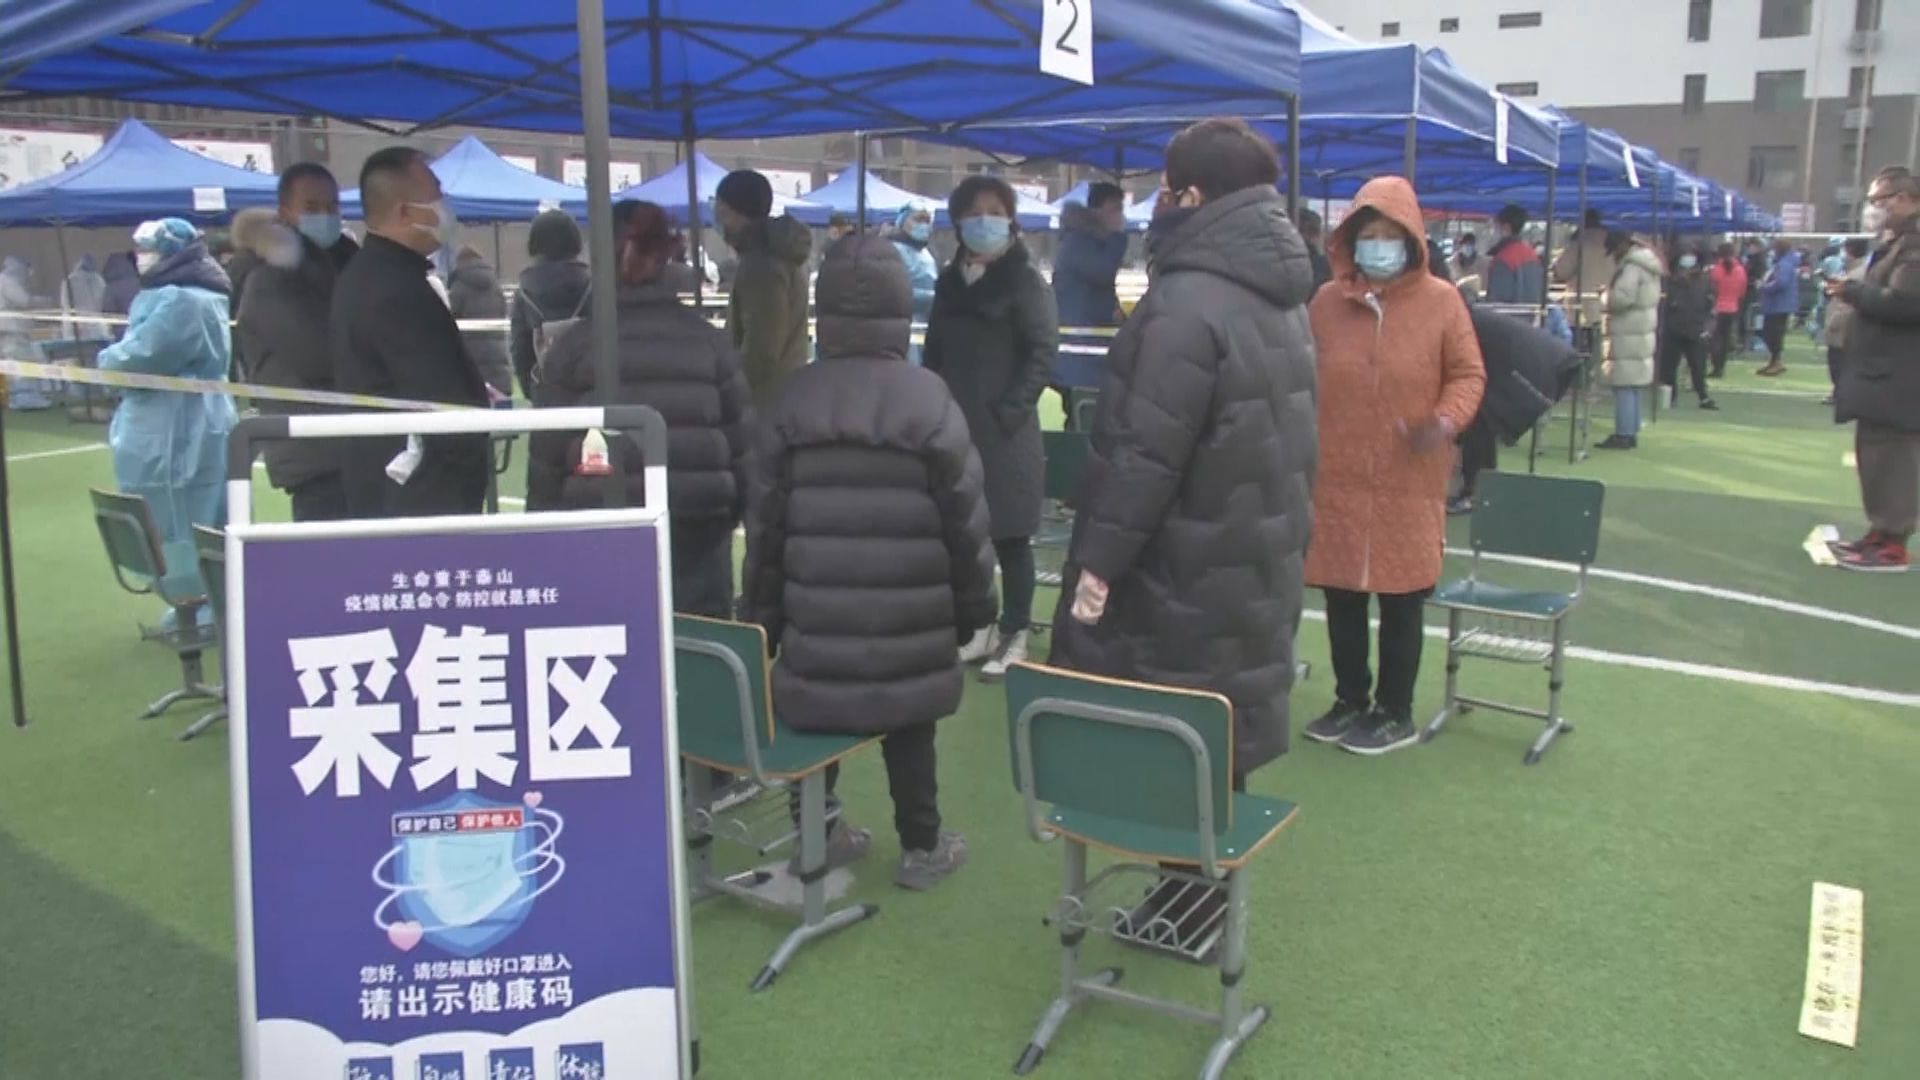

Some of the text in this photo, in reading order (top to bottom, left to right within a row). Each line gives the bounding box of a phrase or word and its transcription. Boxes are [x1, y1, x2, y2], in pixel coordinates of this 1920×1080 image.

[1056, 0, 1079, 55] 2
[392, 568, 513, 589] 生命重于泰山
[344, 587, 559, 612] 疫情就是命令 防控就是责任
[287, 623, 632, 798] 采集区
[397, 812, 519, 832] 保护自己 保护他人
[359, 976, 573, 1020] 请出示健康码
